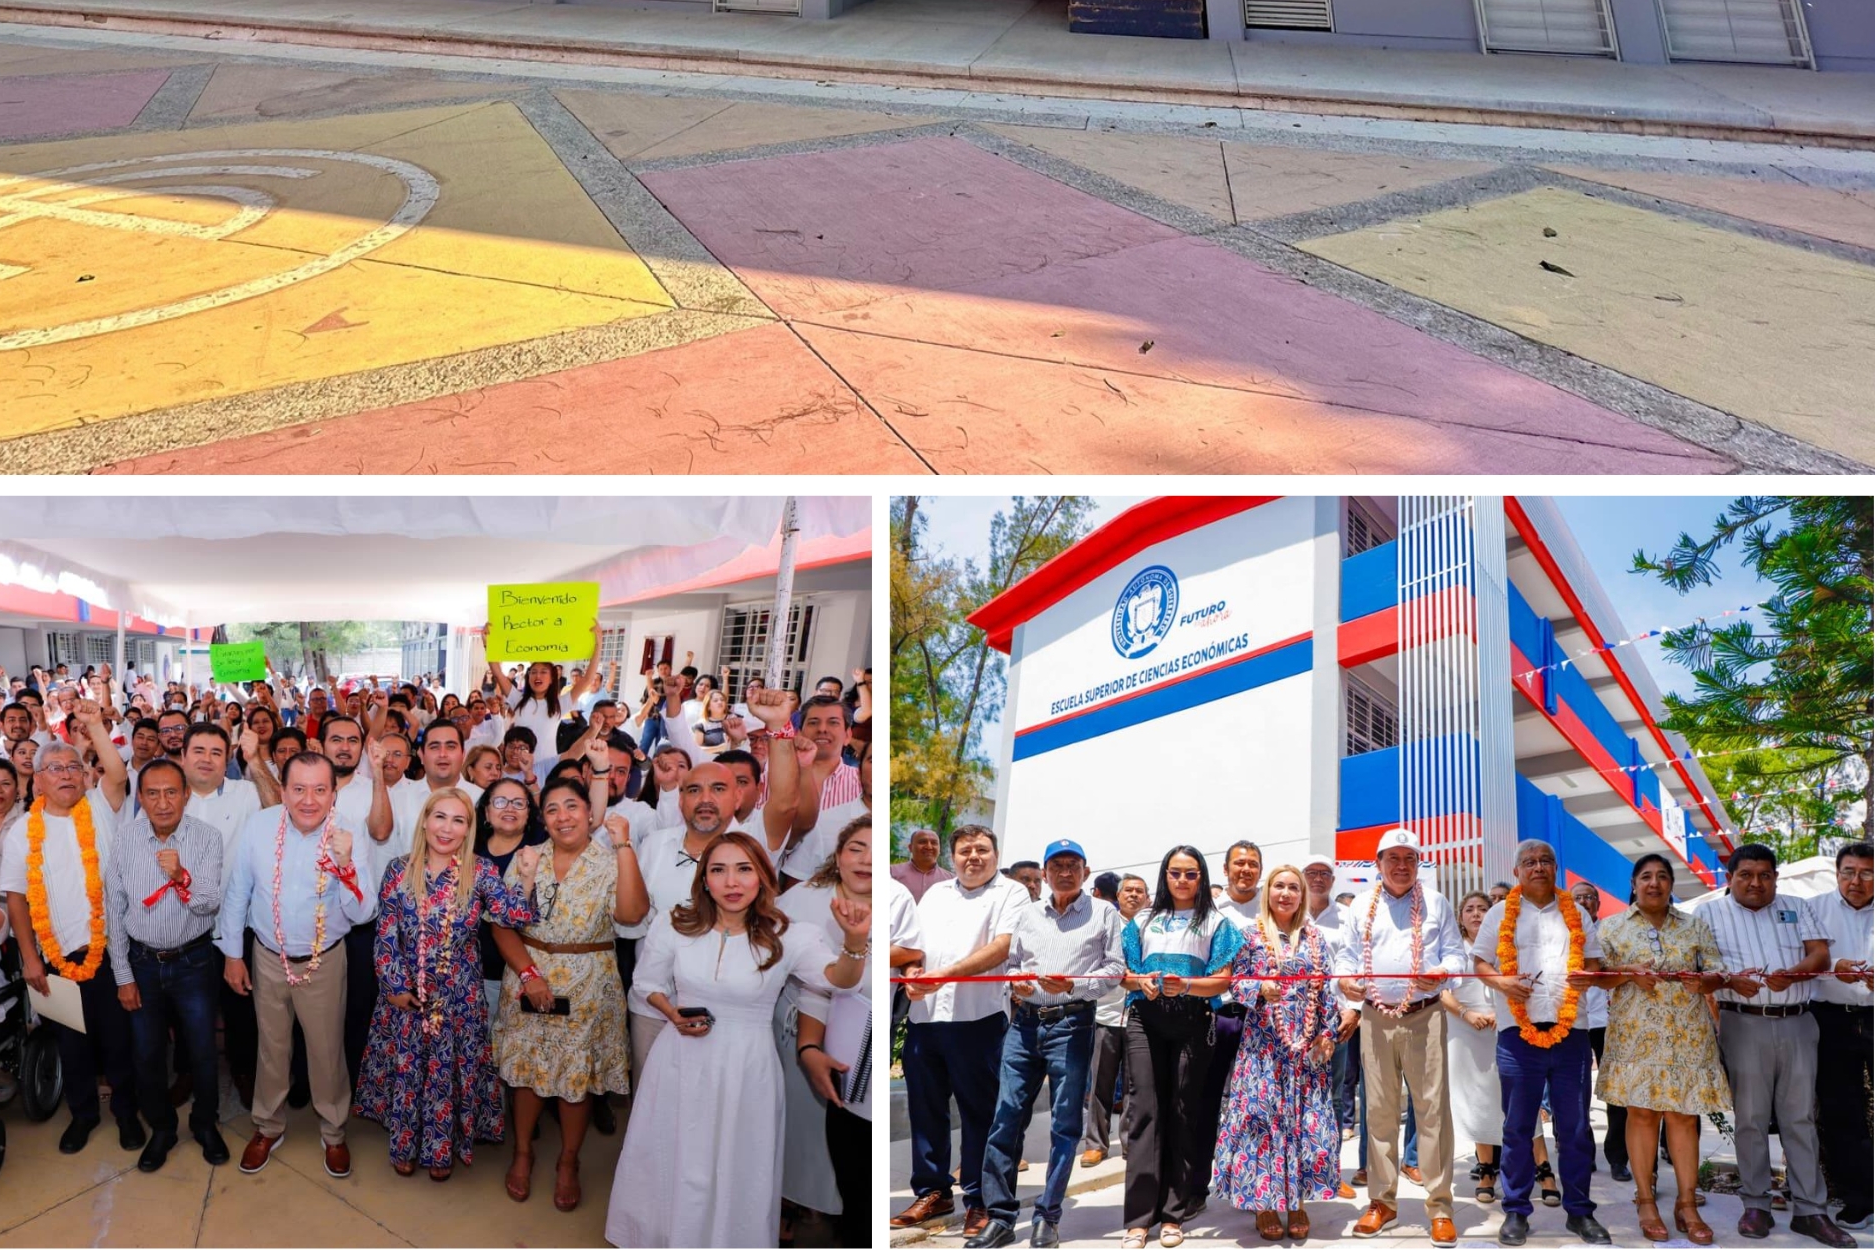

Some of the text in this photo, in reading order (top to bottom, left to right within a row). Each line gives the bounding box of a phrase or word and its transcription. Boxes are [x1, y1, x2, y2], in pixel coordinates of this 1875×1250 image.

[500, 590, 577, 607] Bienvenido
[503, 614, 563, 630] Rector a
[1180, 600, 1226, 627] FUTURO
[1051, 633, 1249, 715] ESCUELA SUPERIOR DE CIENCIAS ECONÓMICAS
